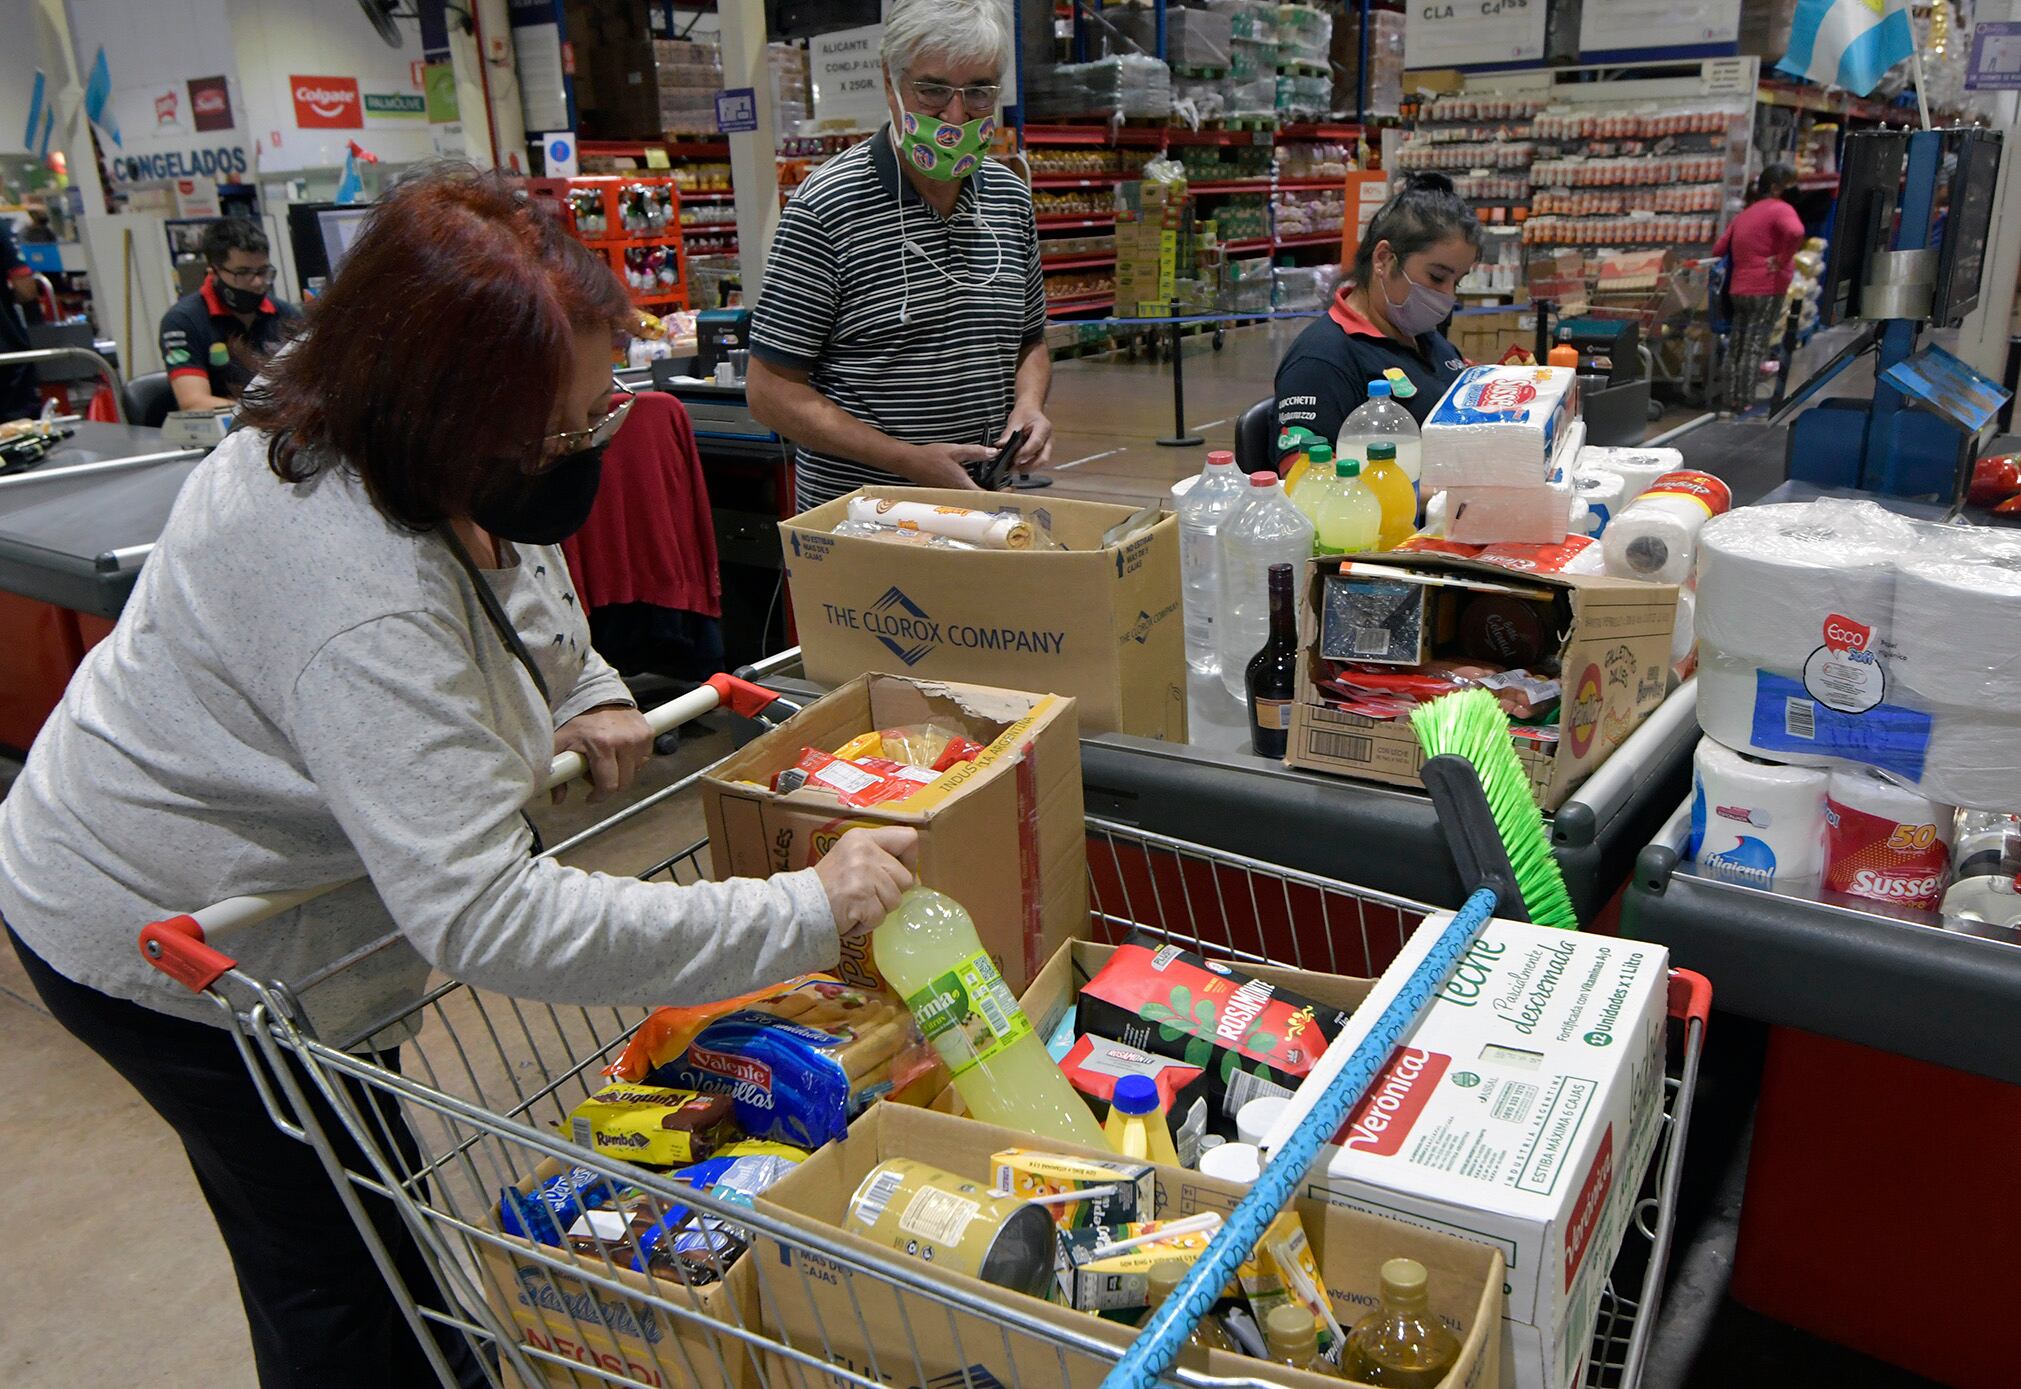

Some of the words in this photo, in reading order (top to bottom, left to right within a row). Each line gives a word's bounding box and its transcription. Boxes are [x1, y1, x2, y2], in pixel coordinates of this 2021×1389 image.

[823, 40, 868, 53] ALICANTE
[296, 86, 354, 105] Colgate
[368, 97, 421, 110] PALMOLIVE
[823, 603, 860, 630] THE
[862, 611, 944, 644] CLOROX
[948, 624, 1065, 655] COMPANY
[990, 717, 1035, 756] ARGENTINA
[1887, 823, 1938, 850] 50
[1706, 851, 1775, 879] Higienol
[1581, 957, 1605, 993] Vitaminas
[1626, 952, 1644, 975] Litro
[1492, 947, 1545, 1012] Parcialmente
[1497, 939, 1577, 1035] descremada
[1621, 980, 1632, 989] x
[1215, 978, 1276, 1041] ROSAMONTE
[1579, 993, 1589, 1006] con
[1594, 986, 1630, 1032] Unidades
[772, 1023, 828, 1043] unidades
[1556, 1002, 1584, 1043] Fortificada
[1591, 1034, 1607, 1047] 12
[694, 1052, 766, 1084] Valente
[1106, 1049, 1155, 1065] ROSAMONTE
[618, 1091, 688, 1107] Rumba
[680, 1071, 776, 1110] Vainillas
[1343, 1050, 1430, 1149] Verónica
[596, 1131, 635, 1147] Rumba
[1503, 1131, 1536, 1188] INDUSTRIA
[1533, 1074, 1563, 1128] ARGENTINA
[1531, 1152, 1556, 1184] ESTIBA
[1548, 1118, 1570, 1155] MÁXIMA
[1566, 1083, 1586, 1111] CAJAS
[801, 1251, 827, 1268] MAS
[1327, 1288, 1380, 1308] COMPAN
